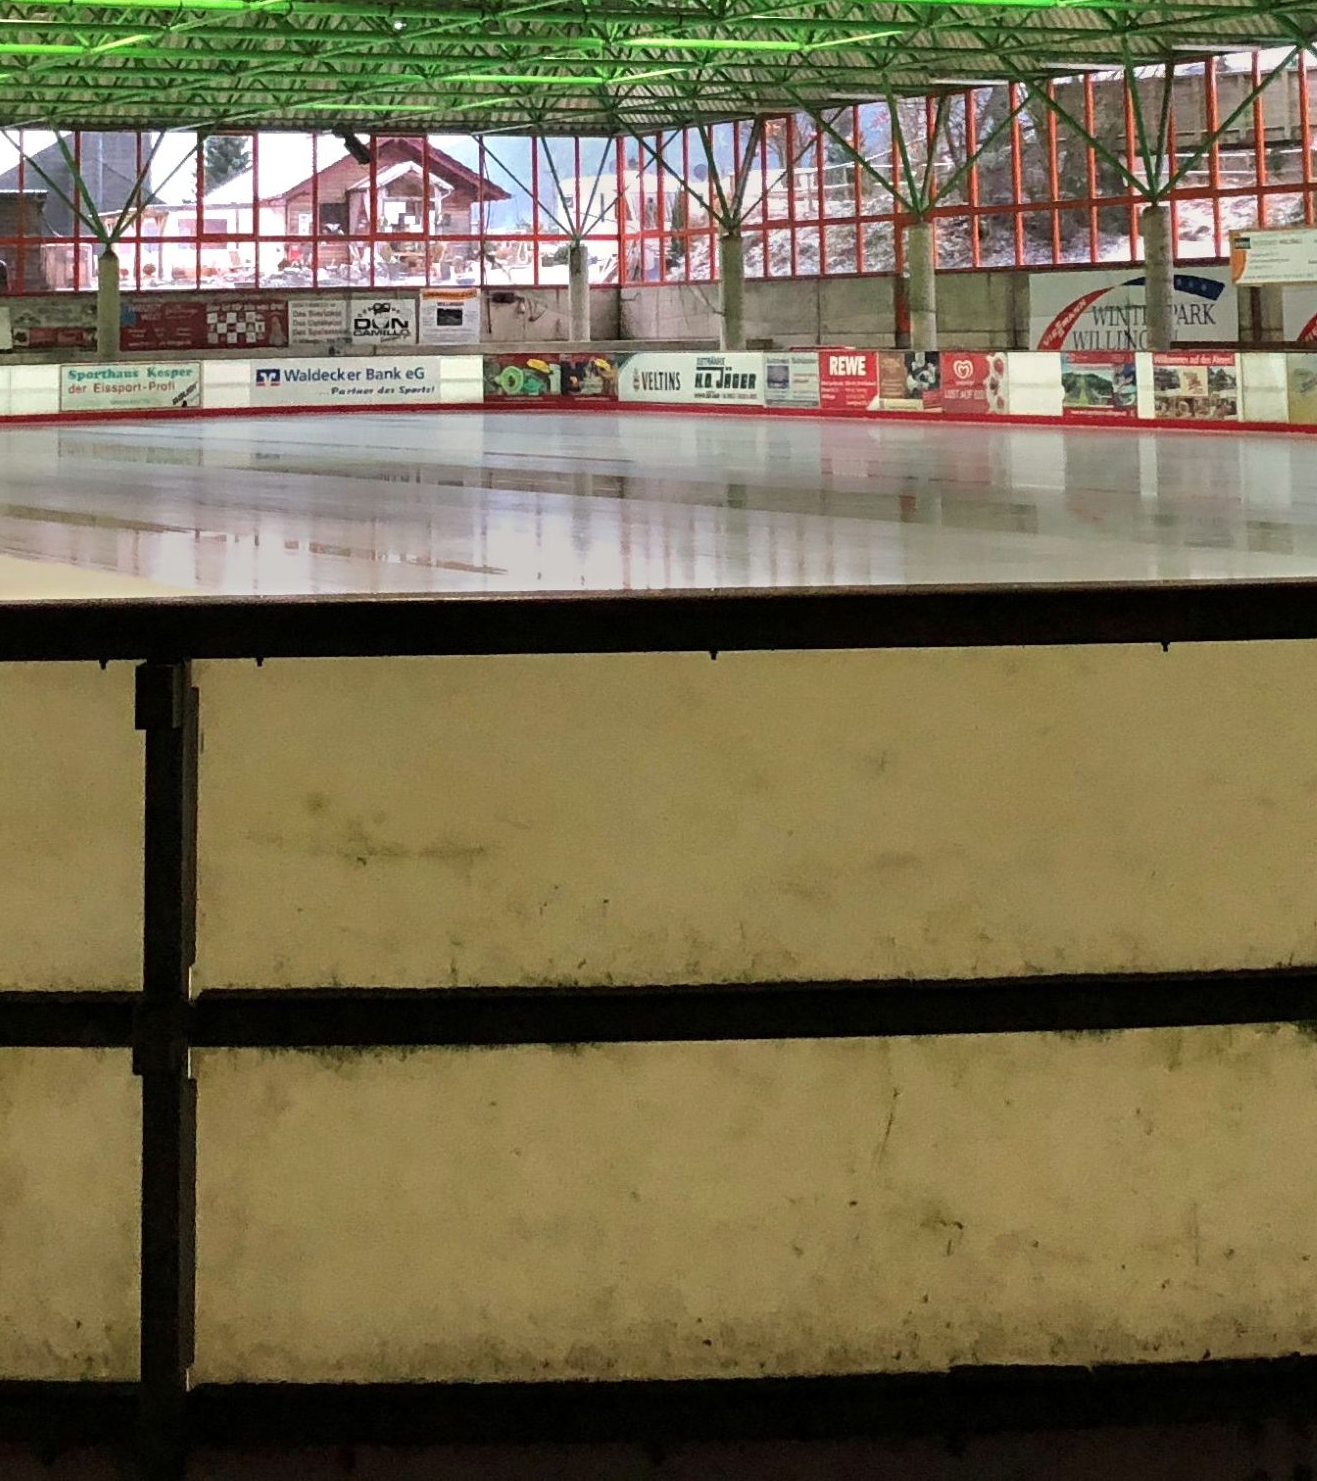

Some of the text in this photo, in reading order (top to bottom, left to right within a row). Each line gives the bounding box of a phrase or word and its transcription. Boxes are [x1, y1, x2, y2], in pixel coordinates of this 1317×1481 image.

[829, 356, 866, 376] REWE
[68, 367, 193, 381] Sporthaus Kesper
[284, 367, 425, 382] Waldecker Bank eG
[641, 372, 681, 390] VELTINS
[68, 383, 87, 394] der
